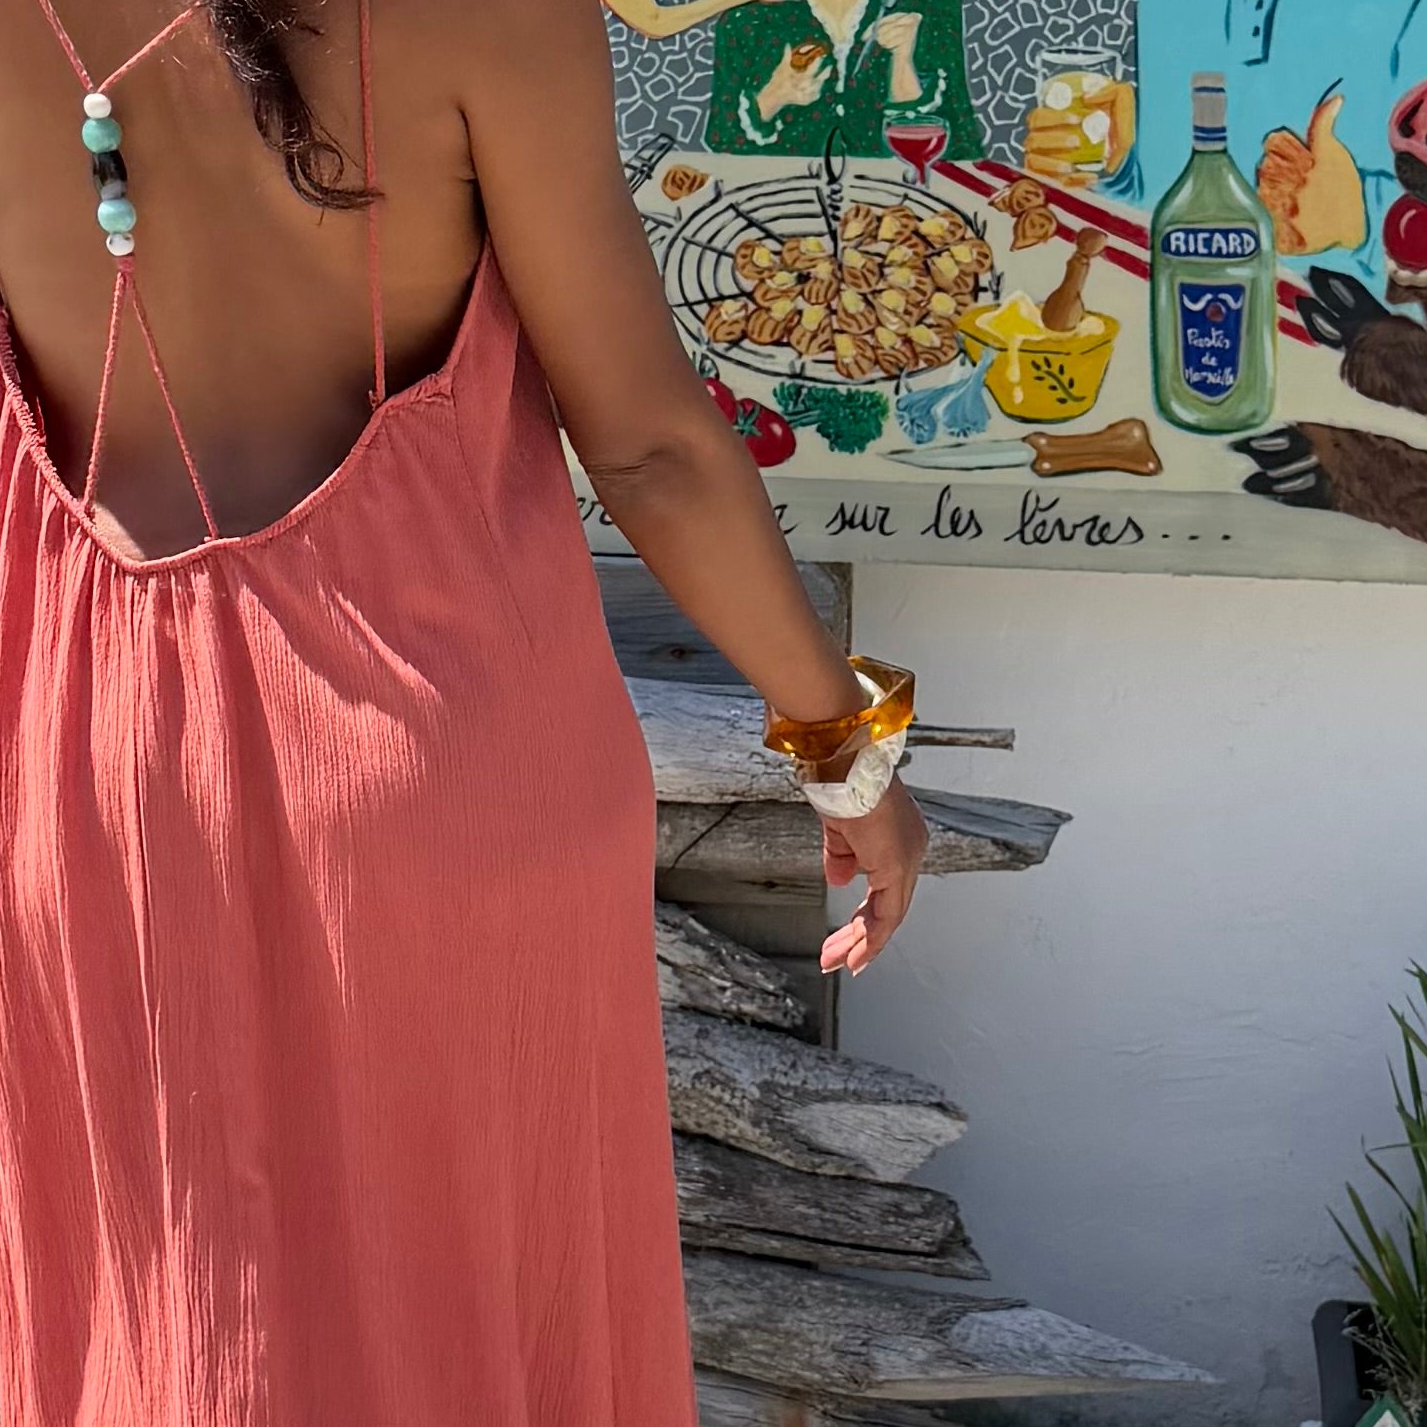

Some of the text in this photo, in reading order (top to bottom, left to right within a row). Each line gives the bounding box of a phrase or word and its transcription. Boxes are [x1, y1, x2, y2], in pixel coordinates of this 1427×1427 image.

[1169, 231, 1257, 256] RICARD
[1201, 352, 1219, 367] de
[825, 501, 898, 537] sur
[920, 484, 984, 539] les
